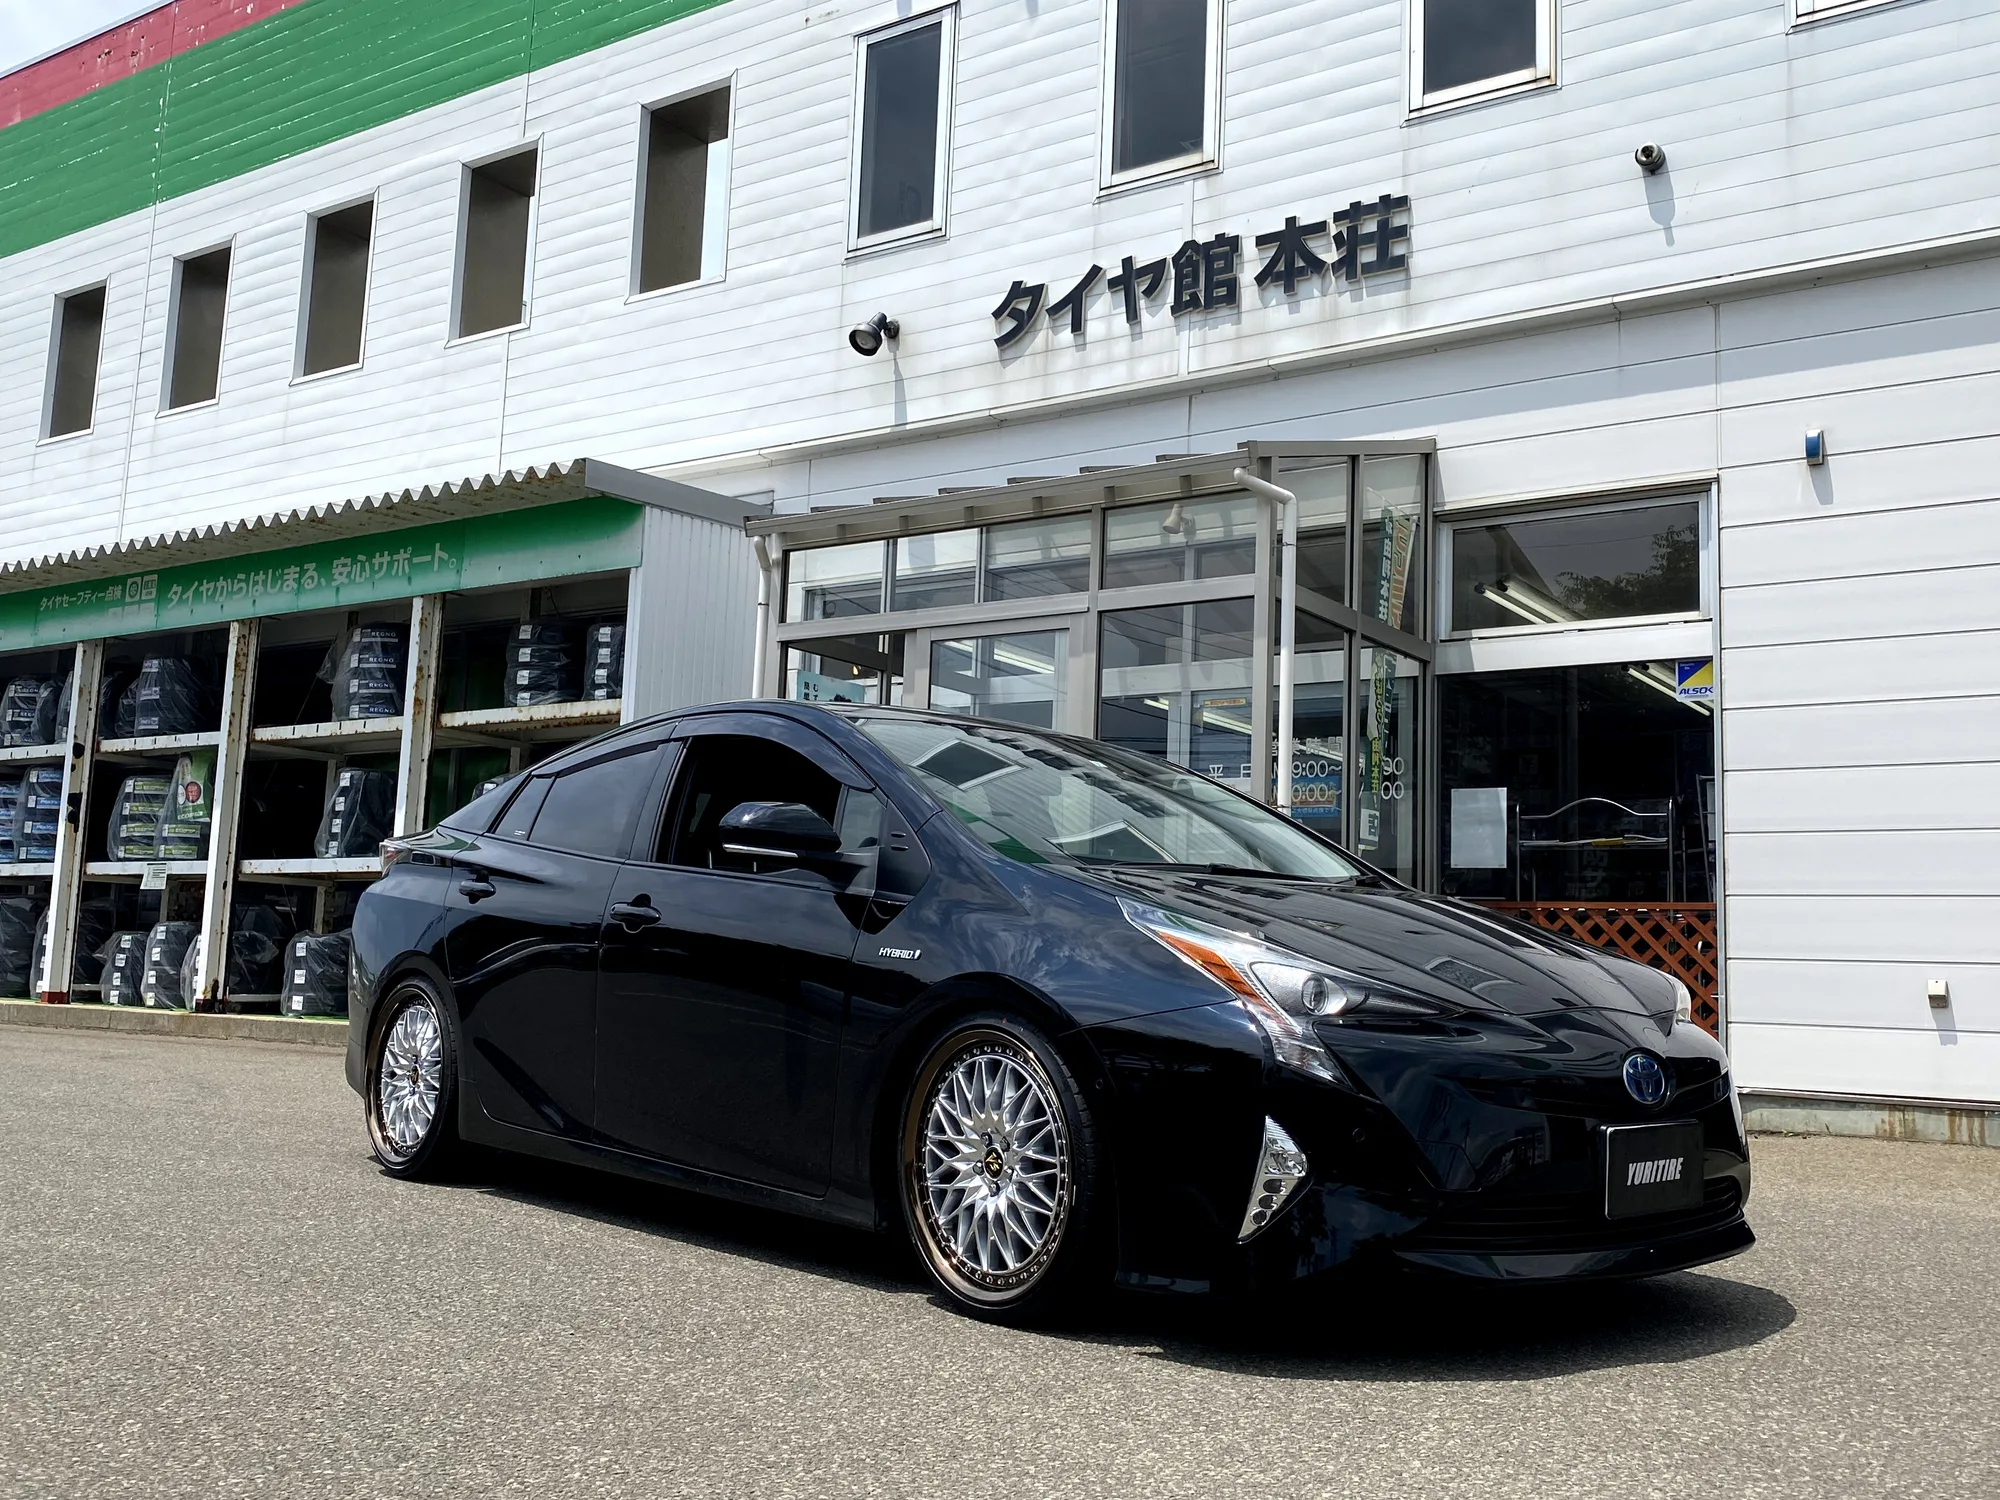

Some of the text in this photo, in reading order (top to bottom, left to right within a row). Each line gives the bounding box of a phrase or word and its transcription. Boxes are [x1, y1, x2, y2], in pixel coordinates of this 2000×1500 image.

[167, 543, 456, 609] タイヤからはじまる、安心サポート。
[40, 584, 123, 611] タイヤセーフティー点検
[1679, 687, 1713, 695] ALSOK
[878, 947, 914, 959] HYBRID
[1626, 1157, 1684, 1186] YURITIRE
